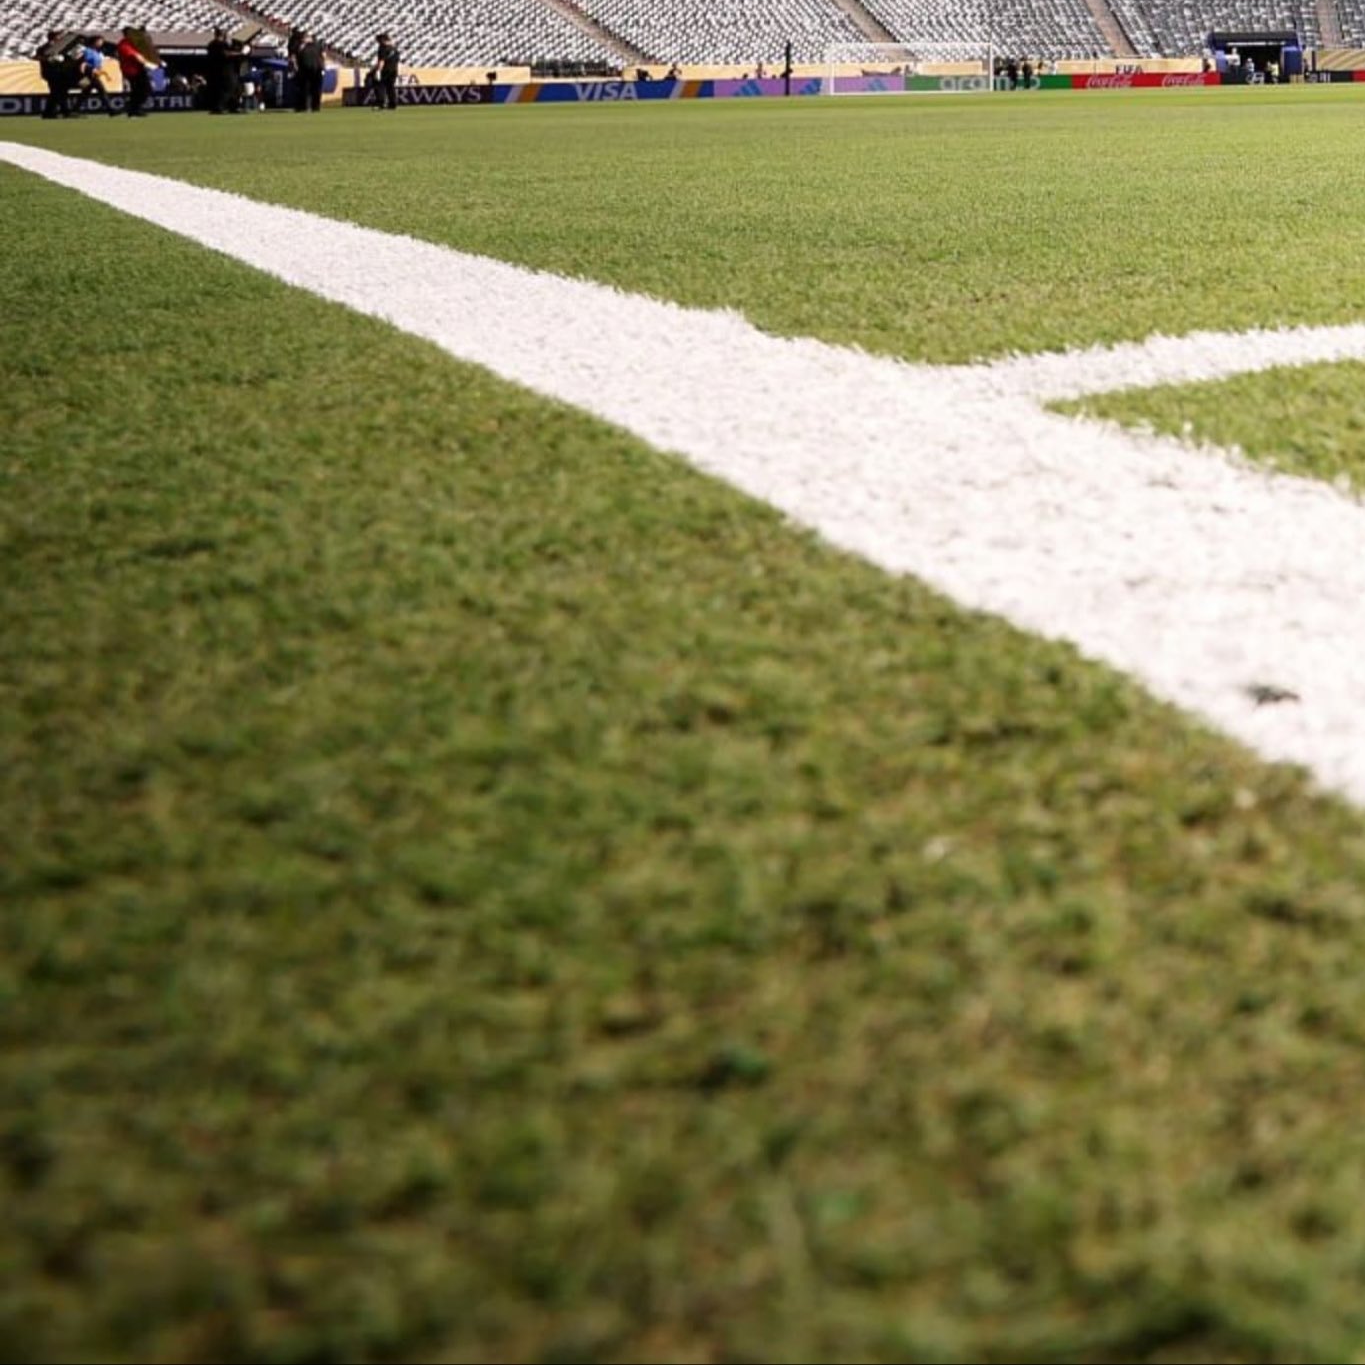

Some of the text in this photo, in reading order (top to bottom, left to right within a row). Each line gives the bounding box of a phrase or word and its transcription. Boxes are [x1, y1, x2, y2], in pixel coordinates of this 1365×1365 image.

[1115, 64, 1143, 75] FIFA
[363, 85, 482, 105] ARWAYS
[575, 83, 639, 101] VISA
[0, 97, 32, 114] DI
